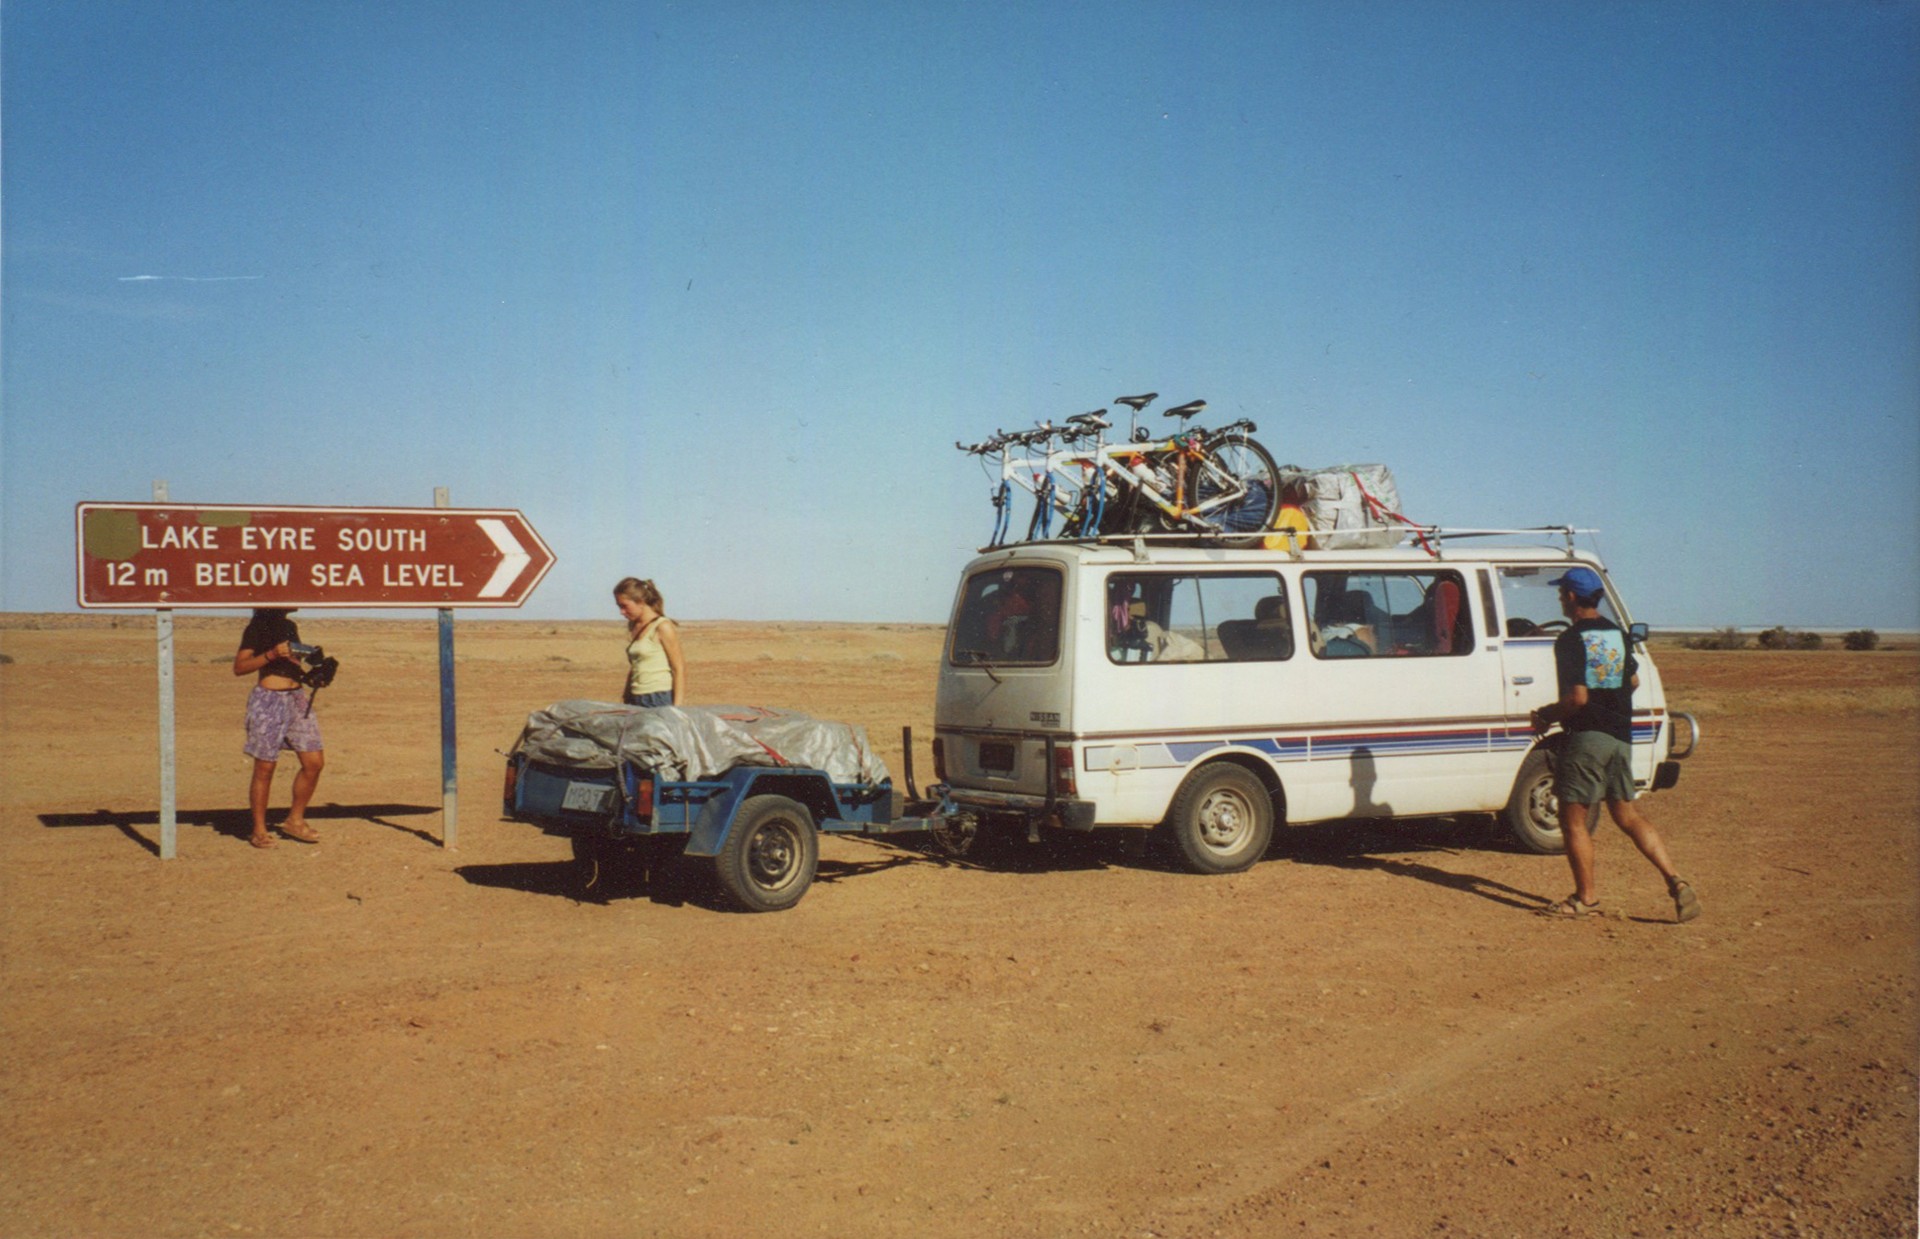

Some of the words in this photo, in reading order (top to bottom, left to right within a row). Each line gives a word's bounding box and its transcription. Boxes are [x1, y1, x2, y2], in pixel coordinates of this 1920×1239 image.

[142, 525, 219, 549] LAKE
[241, 526, 316, 550] EYRE
[338, 527, 426, 552] SOUTH
[106, 562, 136, 586] 12
[145, 568, 168, 586] m
[195, 562, 290, 587] BELOW
[310, 563, 365, 587] SEA
[383, 564, 464, 587] LEVEL
